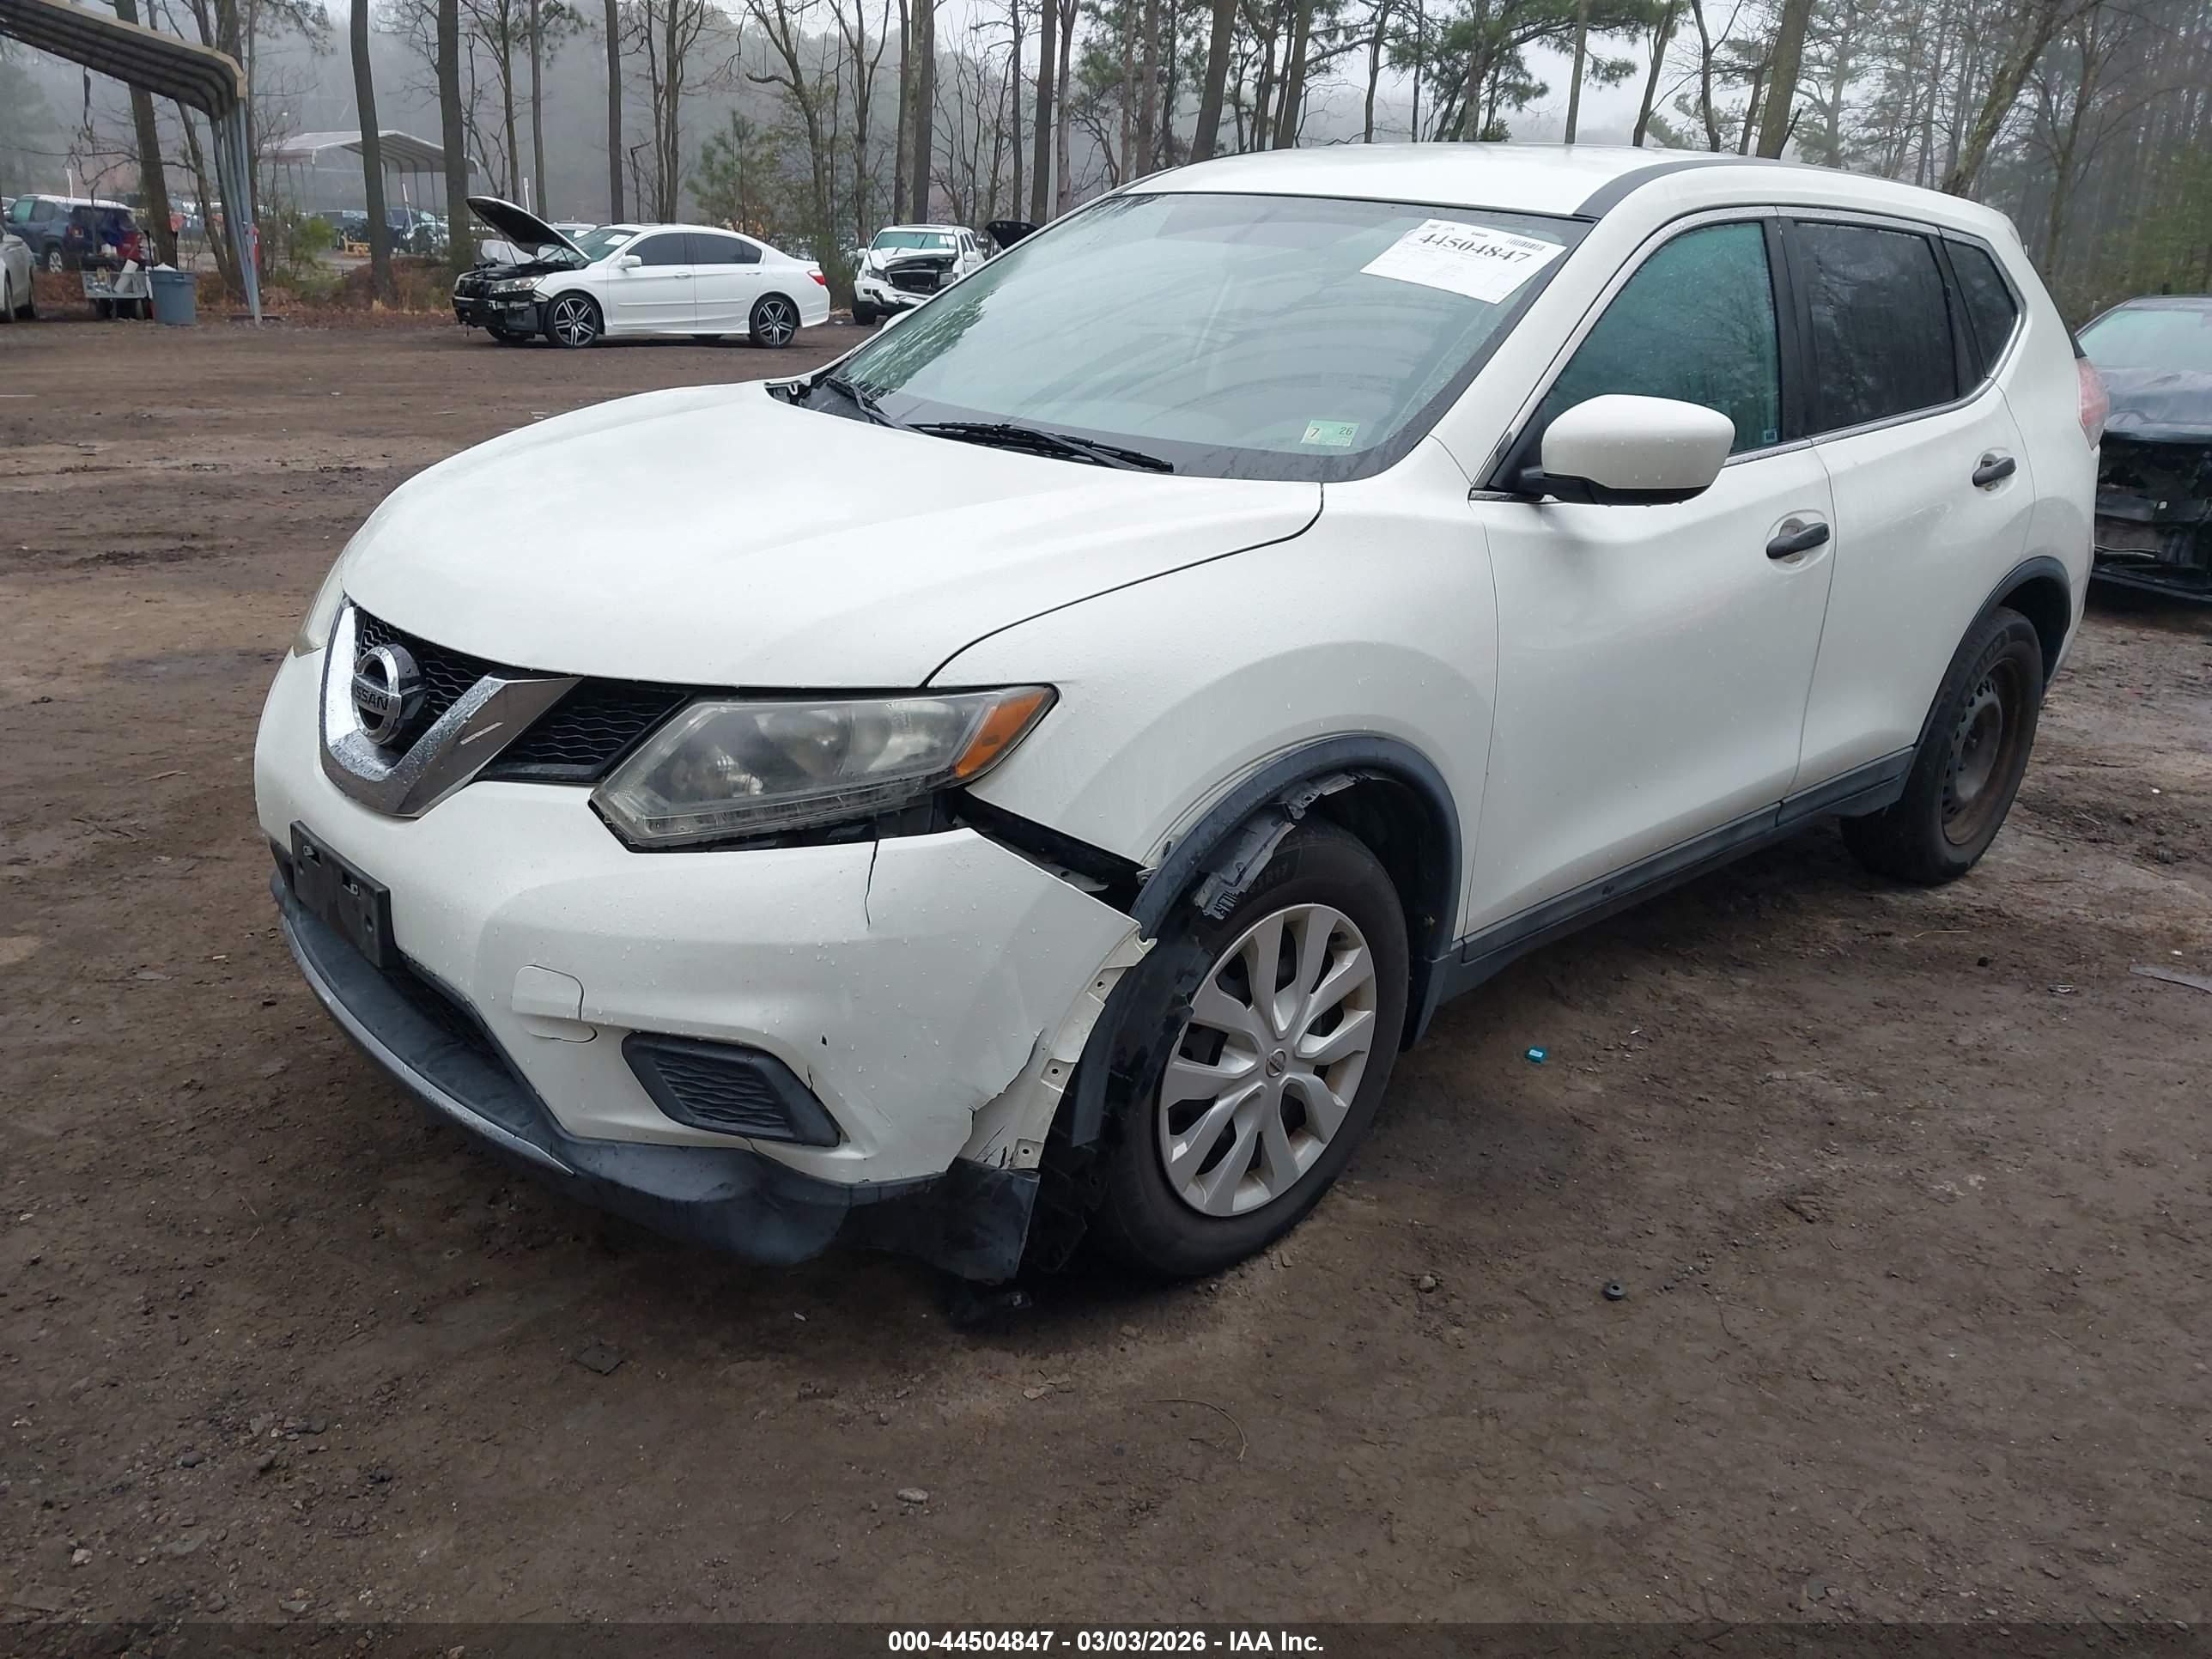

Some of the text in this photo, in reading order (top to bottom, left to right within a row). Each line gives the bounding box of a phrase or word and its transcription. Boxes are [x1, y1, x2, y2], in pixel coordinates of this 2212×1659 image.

[1419, 233, 1532, 263] 44504847
[1310, 426, 1354, 438] 7 26
